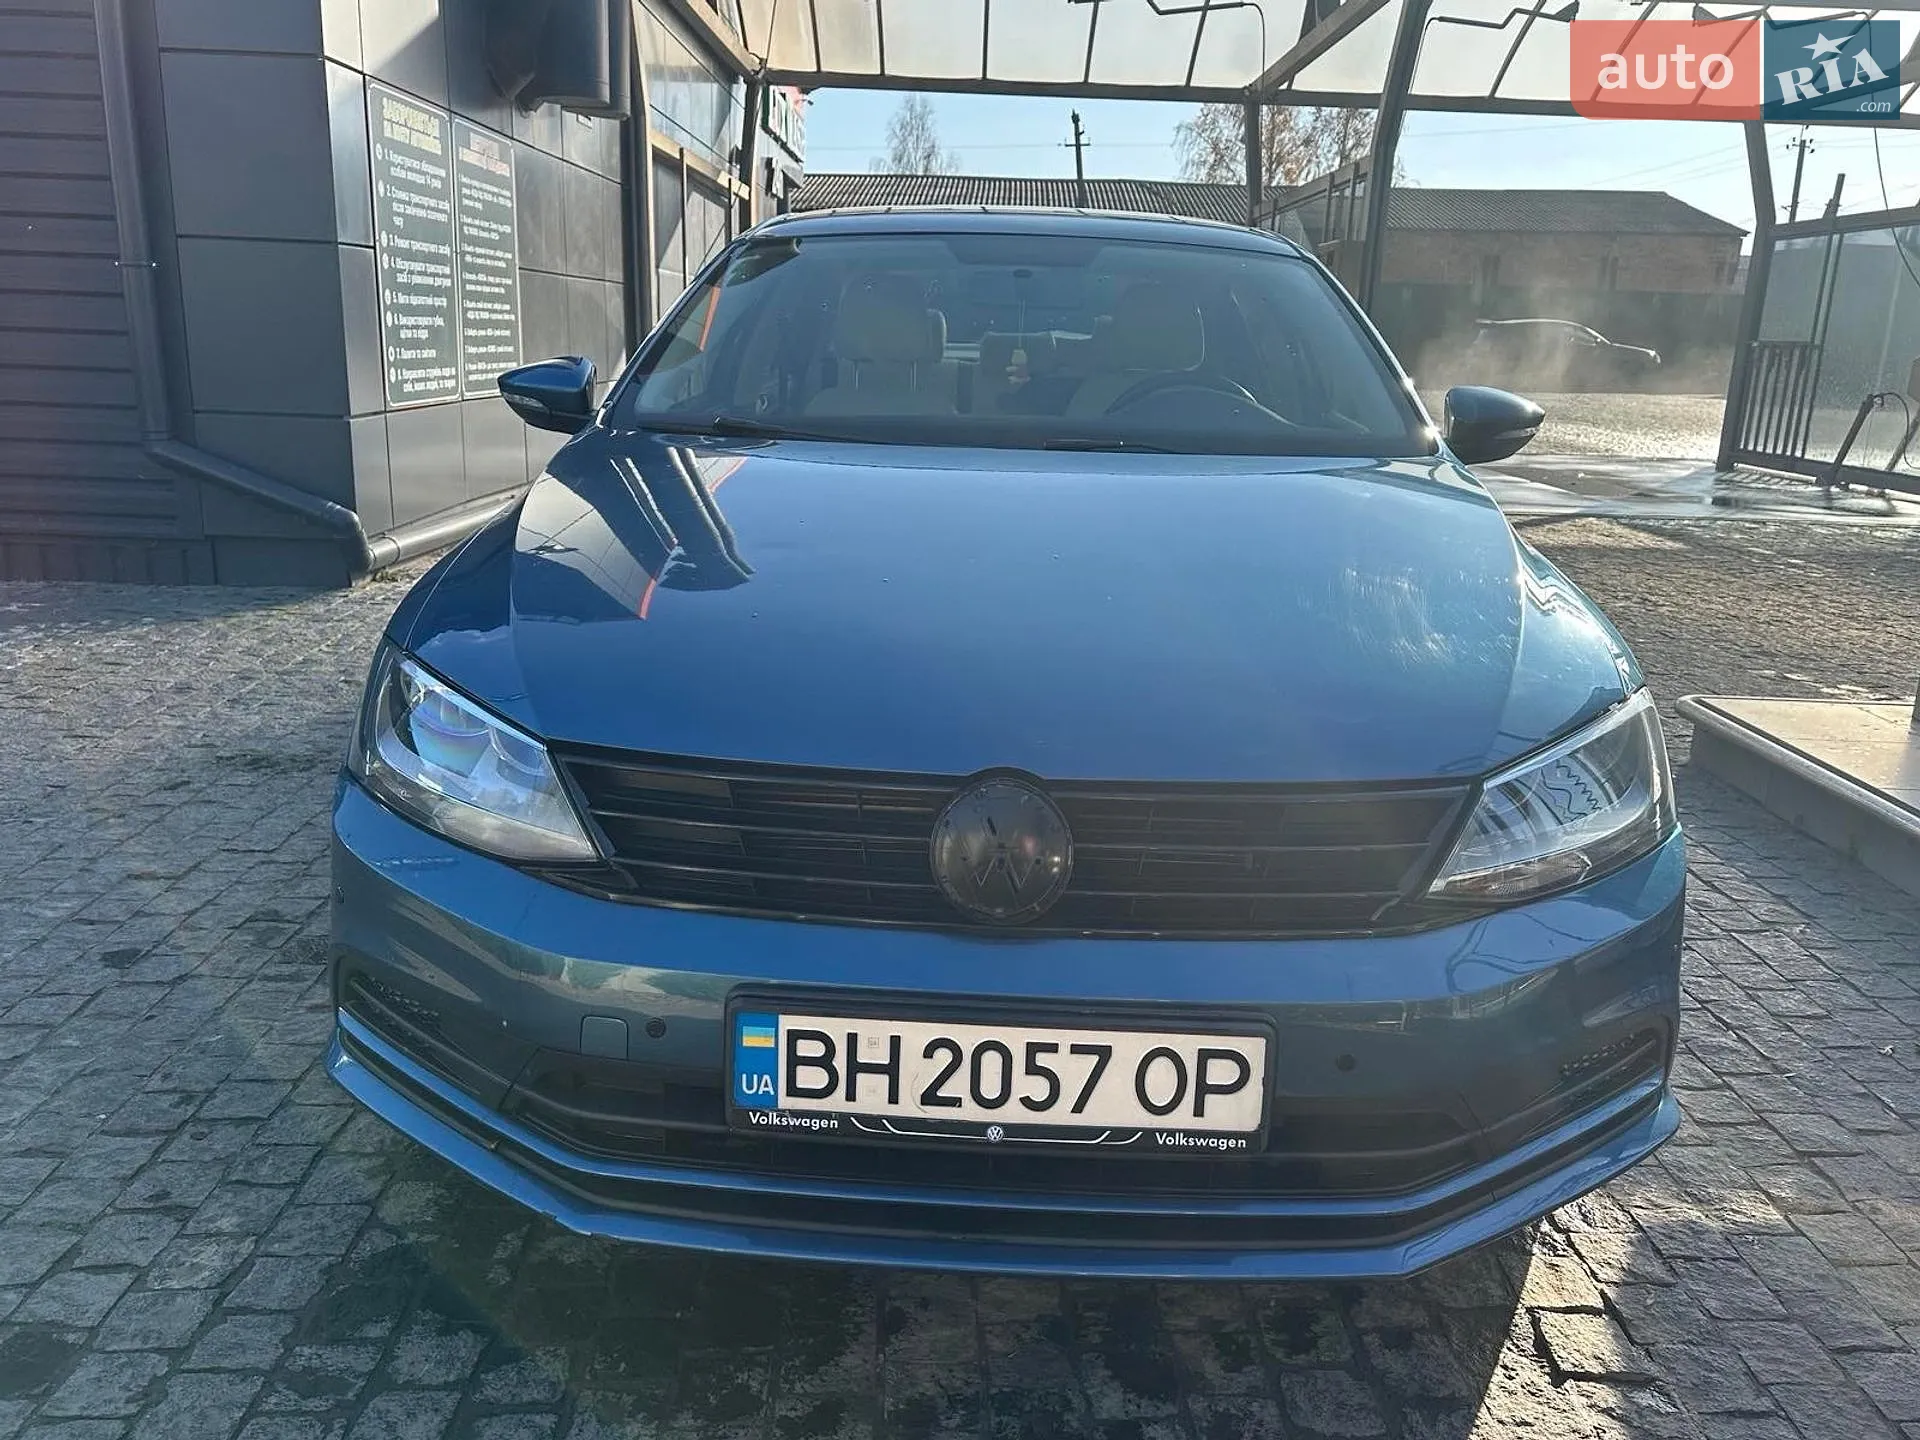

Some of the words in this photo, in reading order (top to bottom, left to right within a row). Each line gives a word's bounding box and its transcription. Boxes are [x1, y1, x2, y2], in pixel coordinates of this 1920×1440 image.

[785, 1028, 901, 1105] BH
[919, 1037, 1113, 1114] 2057
[1134, 1046, 1252, 1118] OP
[742, 1073, 775, 1096] UA
[749, 1111, 838, 1130] Volkswagen
[1155, 1132, 1246, 1150] Volkswagen
